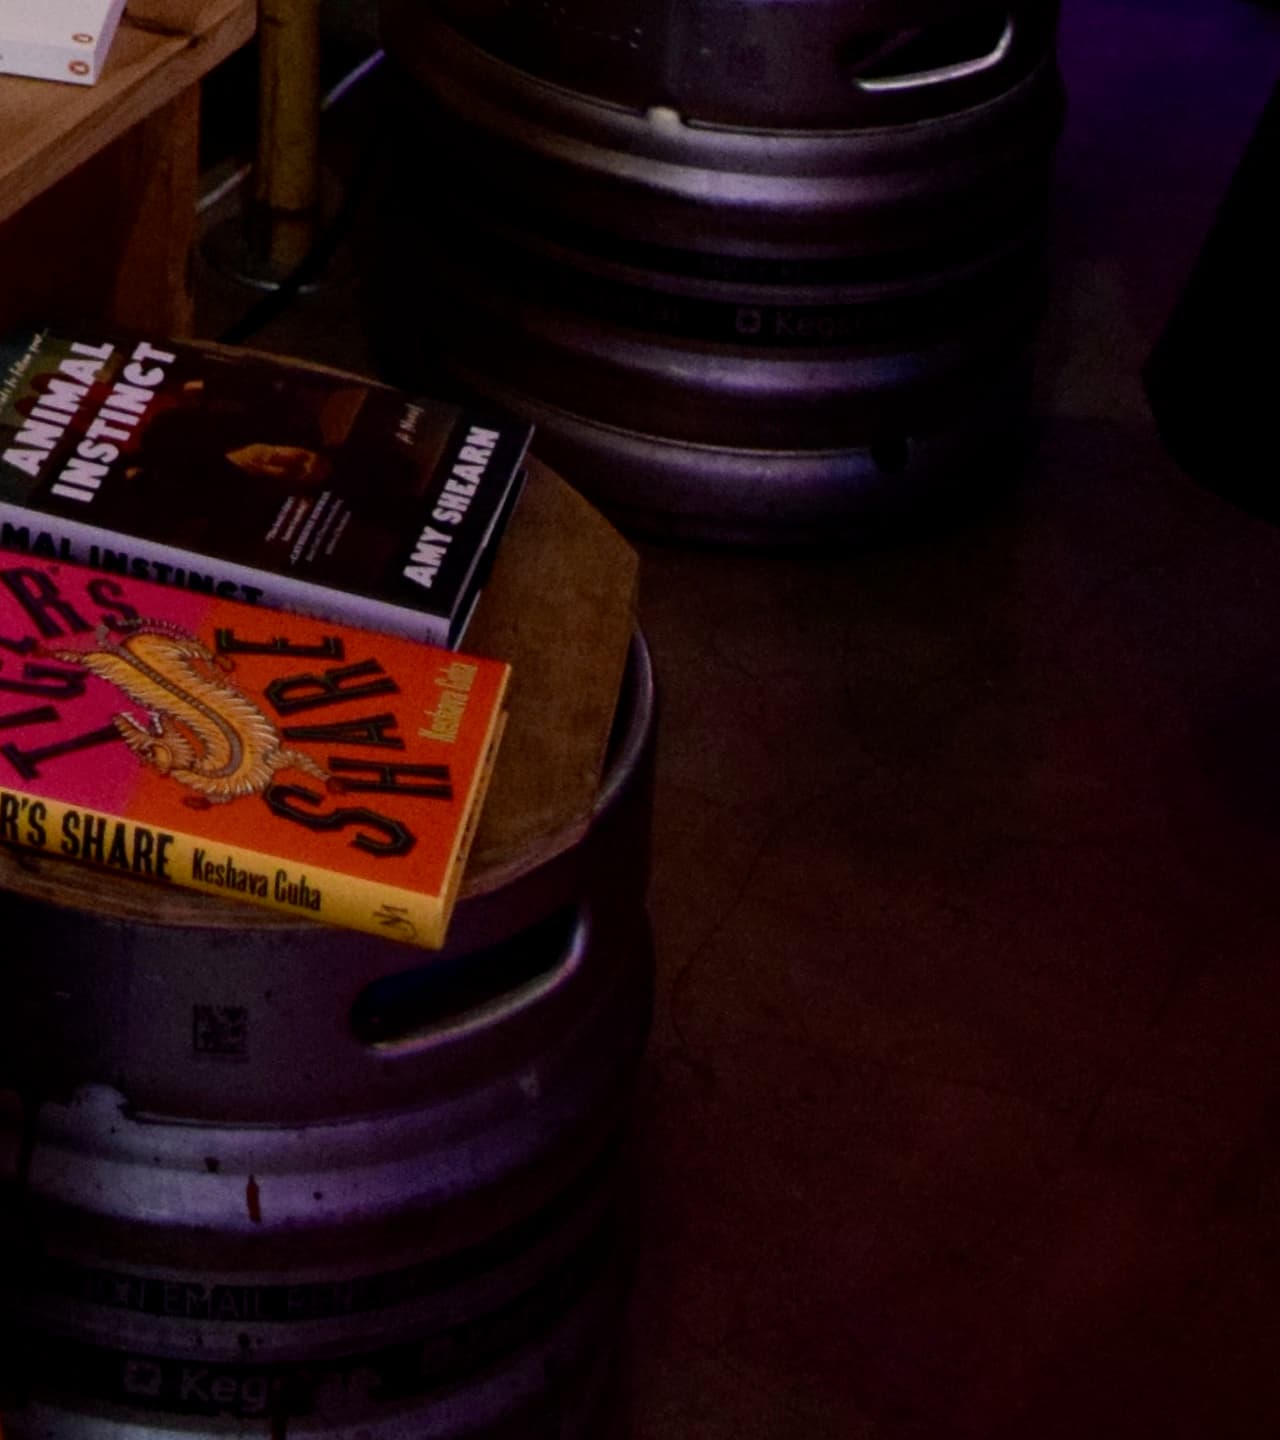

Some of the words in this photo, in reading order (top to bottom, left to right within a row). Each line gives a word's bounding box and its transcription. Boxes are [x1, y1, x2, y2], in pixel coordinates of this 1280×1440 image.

[0, 341, 115, 479] ANIMAL
[49, 341, 178, 505] INSTINCT
[403, 526, 452, 589] AMY
[434, 424, 501, 530] SHEARN
[59, 809, 176, 881] SHARE
[190, 842, 270, 902] Keshava
[273, 871, 322, 912] Guha
